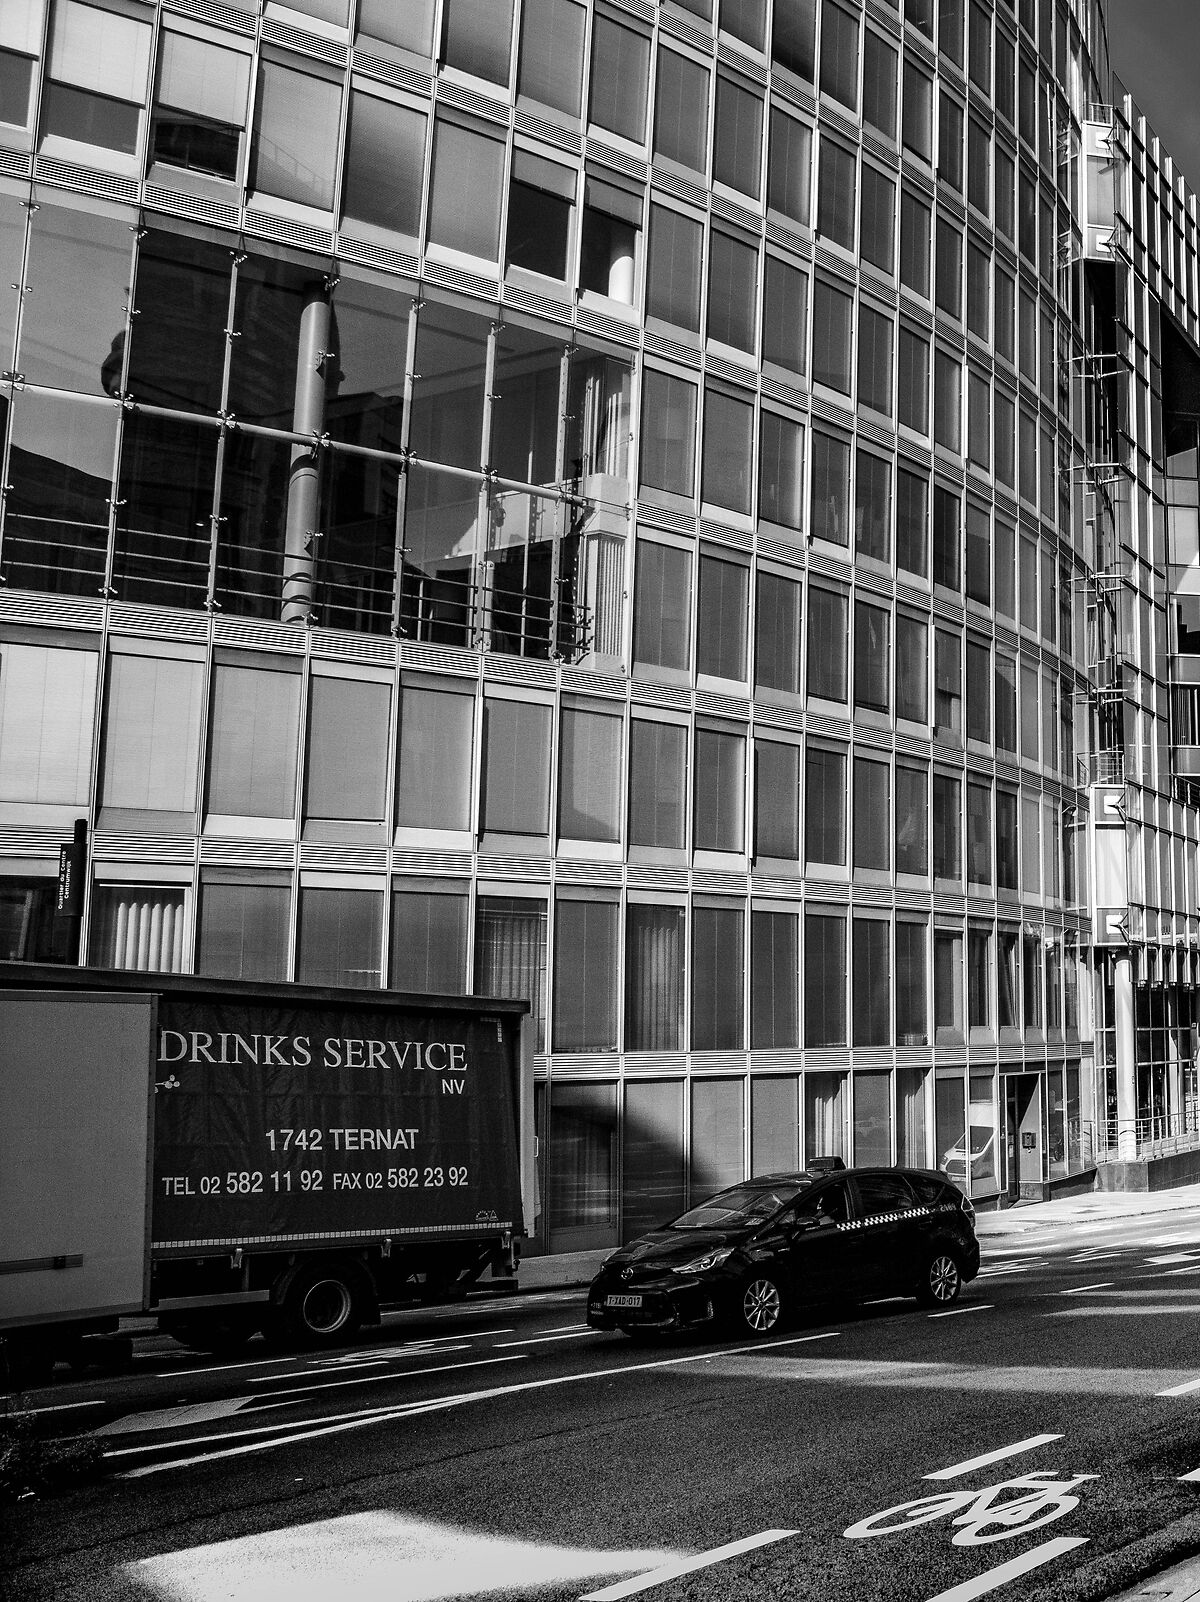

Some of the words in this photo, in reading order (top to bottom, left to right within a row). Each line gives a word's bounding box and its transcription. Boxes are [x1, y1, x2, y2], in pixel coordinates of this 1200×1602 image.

[157, 1030, 312, 1067] DRINKS
[323, 1037, 468, 1072] SERVICE
[441, 1079, 466, 1094] NV
[265, 1129, 323, 1151] 1742
[328, 1128, 420, 1151] TERNAT
[161, 1176, 196, 1196] TEL
[200, 1176, 221, 1194] 02
[225, 1171, 264, 1194] 582
[270, 1170, 293, 1192] 11
[300, 1169, 324, 1191] 92
[332, 1172, 363, 1190] FAX
[365, 1172, 384, 1189] 02
[387, 1167, 420, 1189] 582
[423, 1167, 445, 1188] 23
[448, 1166, 469, 1187] 92
